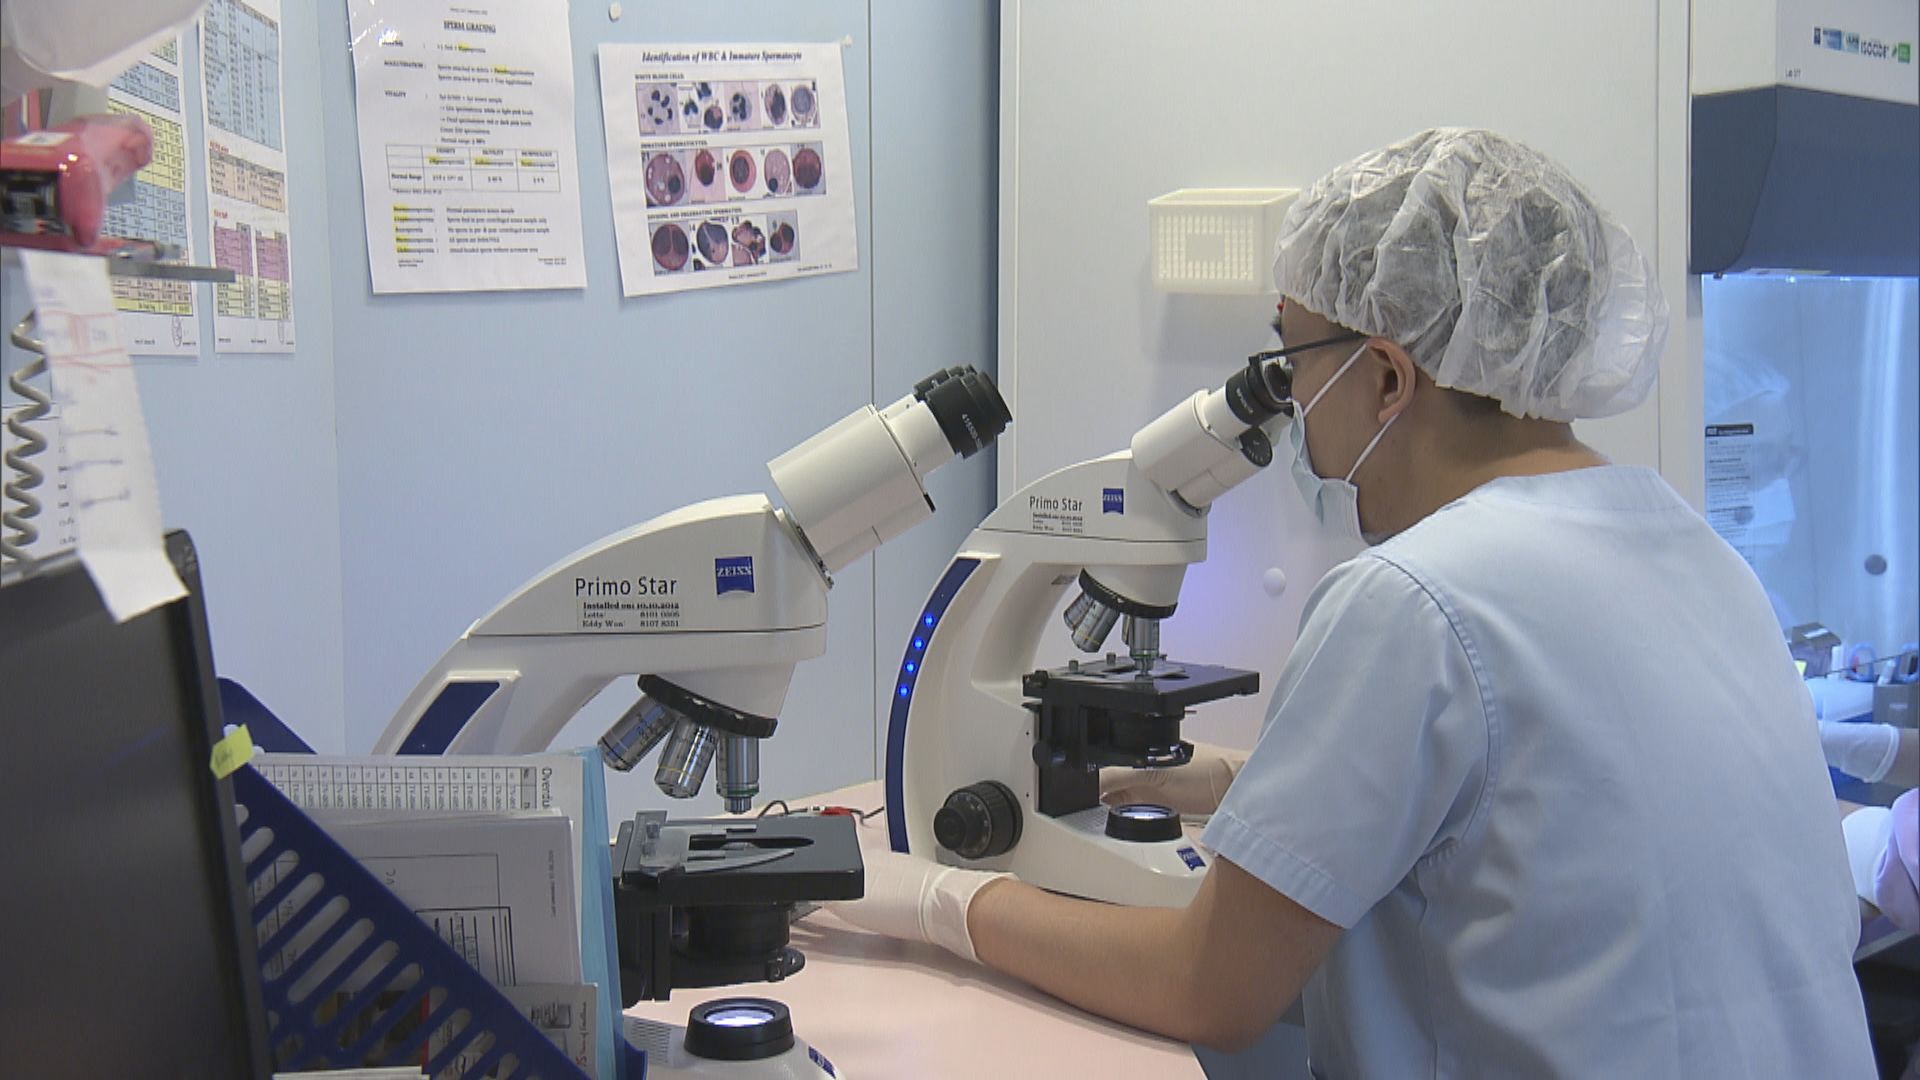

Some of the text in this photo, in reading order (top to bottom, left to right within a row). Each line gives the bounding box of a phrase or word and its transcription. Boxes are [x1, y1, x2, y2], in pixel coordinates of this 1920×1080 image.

[642, 51, 690, 64] Identification
[692, 52, 700, 63] of
[701, 52, 720, 61] WBC
[729, 51, 760, 61] Immature
[1030, 496, 1083, 511] Primo Star
[716, 566, 752, 577] ZEISS
[576, 576, 677, 596] Primo Star
